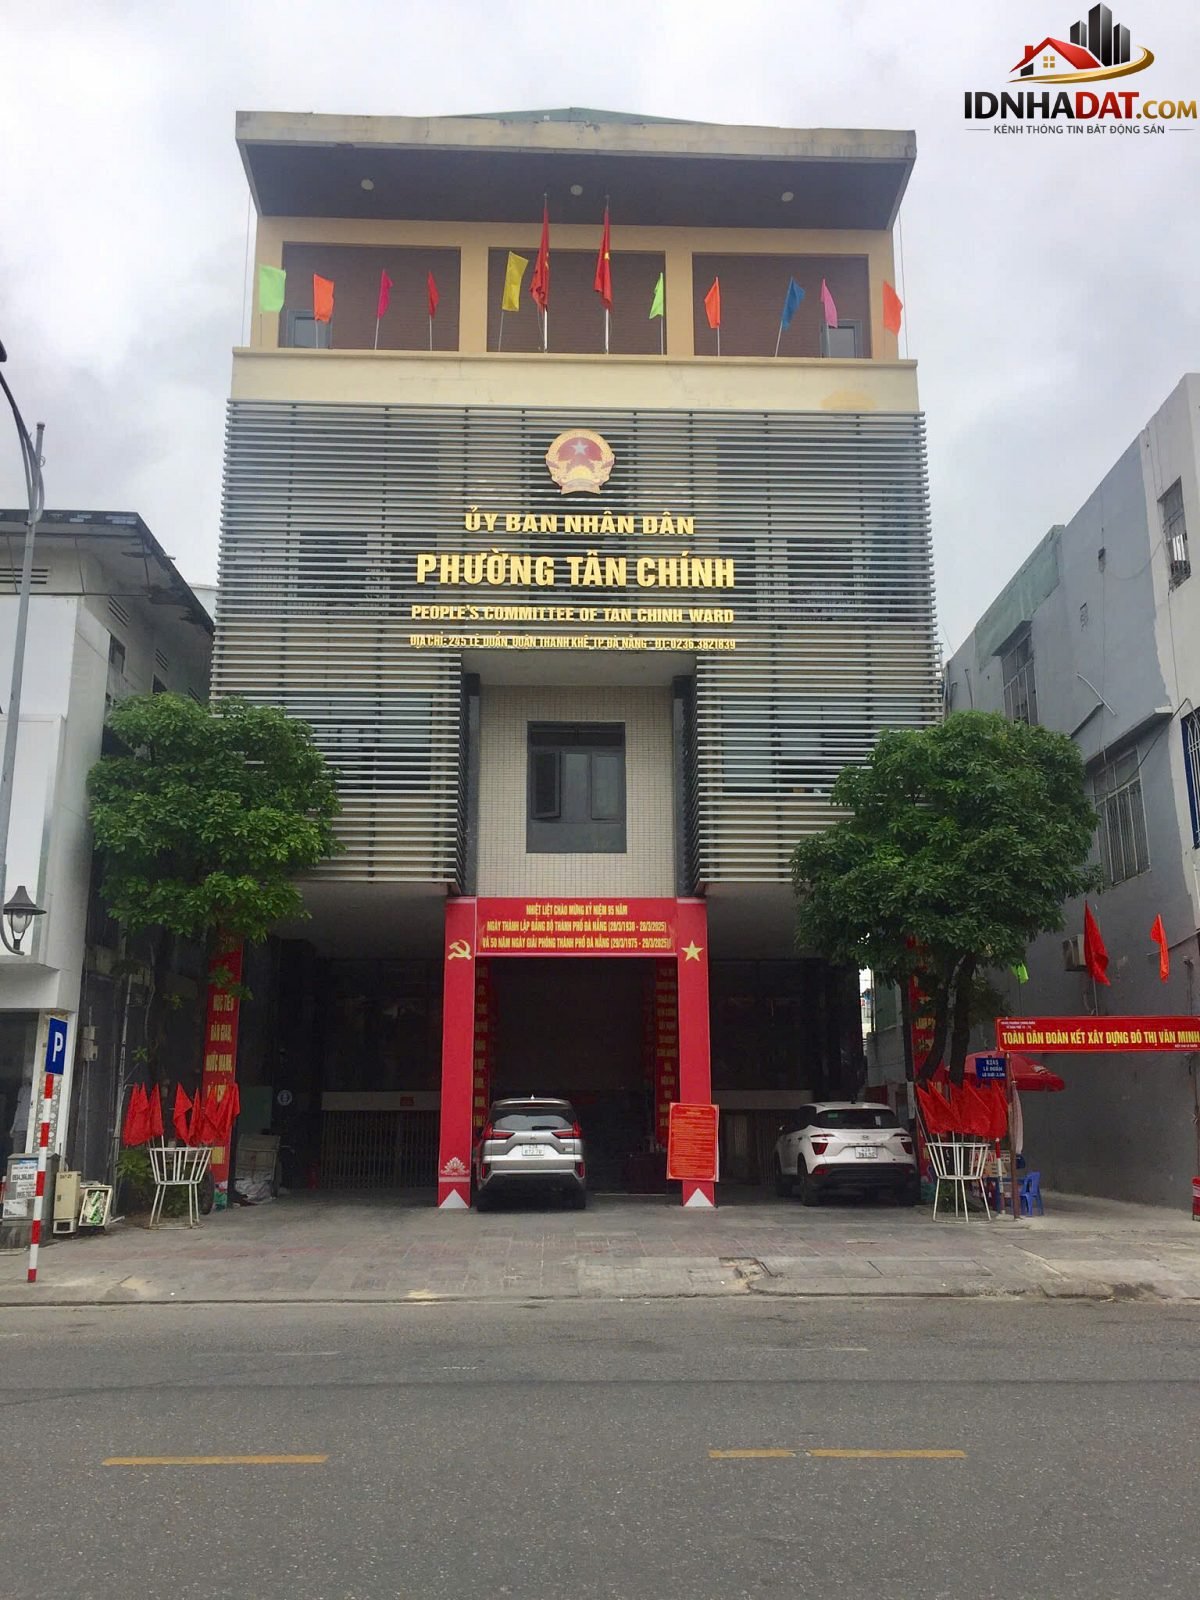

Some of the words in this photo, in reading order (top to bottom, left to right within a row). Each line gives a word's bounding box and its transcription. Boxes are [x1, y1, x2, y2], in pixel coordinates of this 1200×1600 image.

[465, 505, 498, 532] ỦY
[505, 513, 558, 533] BAN
[564, 507, 634, 534] NHÂN
[642, 510, 695, 535] DÂN
[416, 548, 555, 586] PHƯỜNG
[567, 549, 627, 587] TÂN
[636, 551, 735, 588] CHÍNH
[411, 604, 479, 620] PEOPLE'S
[484, 606, 575, 621] COMMITTEE
[579, 607, 598, 622] OF
[603, 608, 632, 622] TAN
[637, 608, 683, 623] CHINH
[689, 609, 734, 623] WARD
[448, 635, 466, 647] 245
[470, 633, 480, 647] LÊ
[539, 634, 568, 648] THANH
[606, 634, 619, 648] ĐÀ
[622, 633, 647, 649] NẴNG
[542, 903, 553, 917] LIỆT
[554, 903, 568, 916] CHÀO
[568, 902, 584, 916] MỪNG
[615, 903, 628, 916] NĂM
[487, 919, 501, 932] NGÀY
[573, 917, 583, 932] PHỐ
[483, 935, 490, 949] VÀ
[490, 938, 497, 948] 50
[498, 935, 511, 948] NĂM
[511, 935, 526, 948] NGÀY
[538, 935, 556, 948] PHÓNG
[575, 934, 586, 948] PHỐ
[53, 1031, 64, 1062] P
[1002, 1029, 1025, 1044] TOÀN
[1026, 1029, 1044, 1044] DÂN
[1046, 1029, 1069, 1044] ĐOÀN
[1070, 1028, 1085, 1044] KẾT
[1088, 1029, 1104, 1044] XÂY
[1105, 1030, 1129, 1047] DỰNG
[1130, 1029, 1142, 1044] ĐÔ
[1144, 1031, 1157, 1047] THỊ
[1159, 1028, 1176, 1044] VĂN
[1177, 1031, 1200, 1043] MINH
